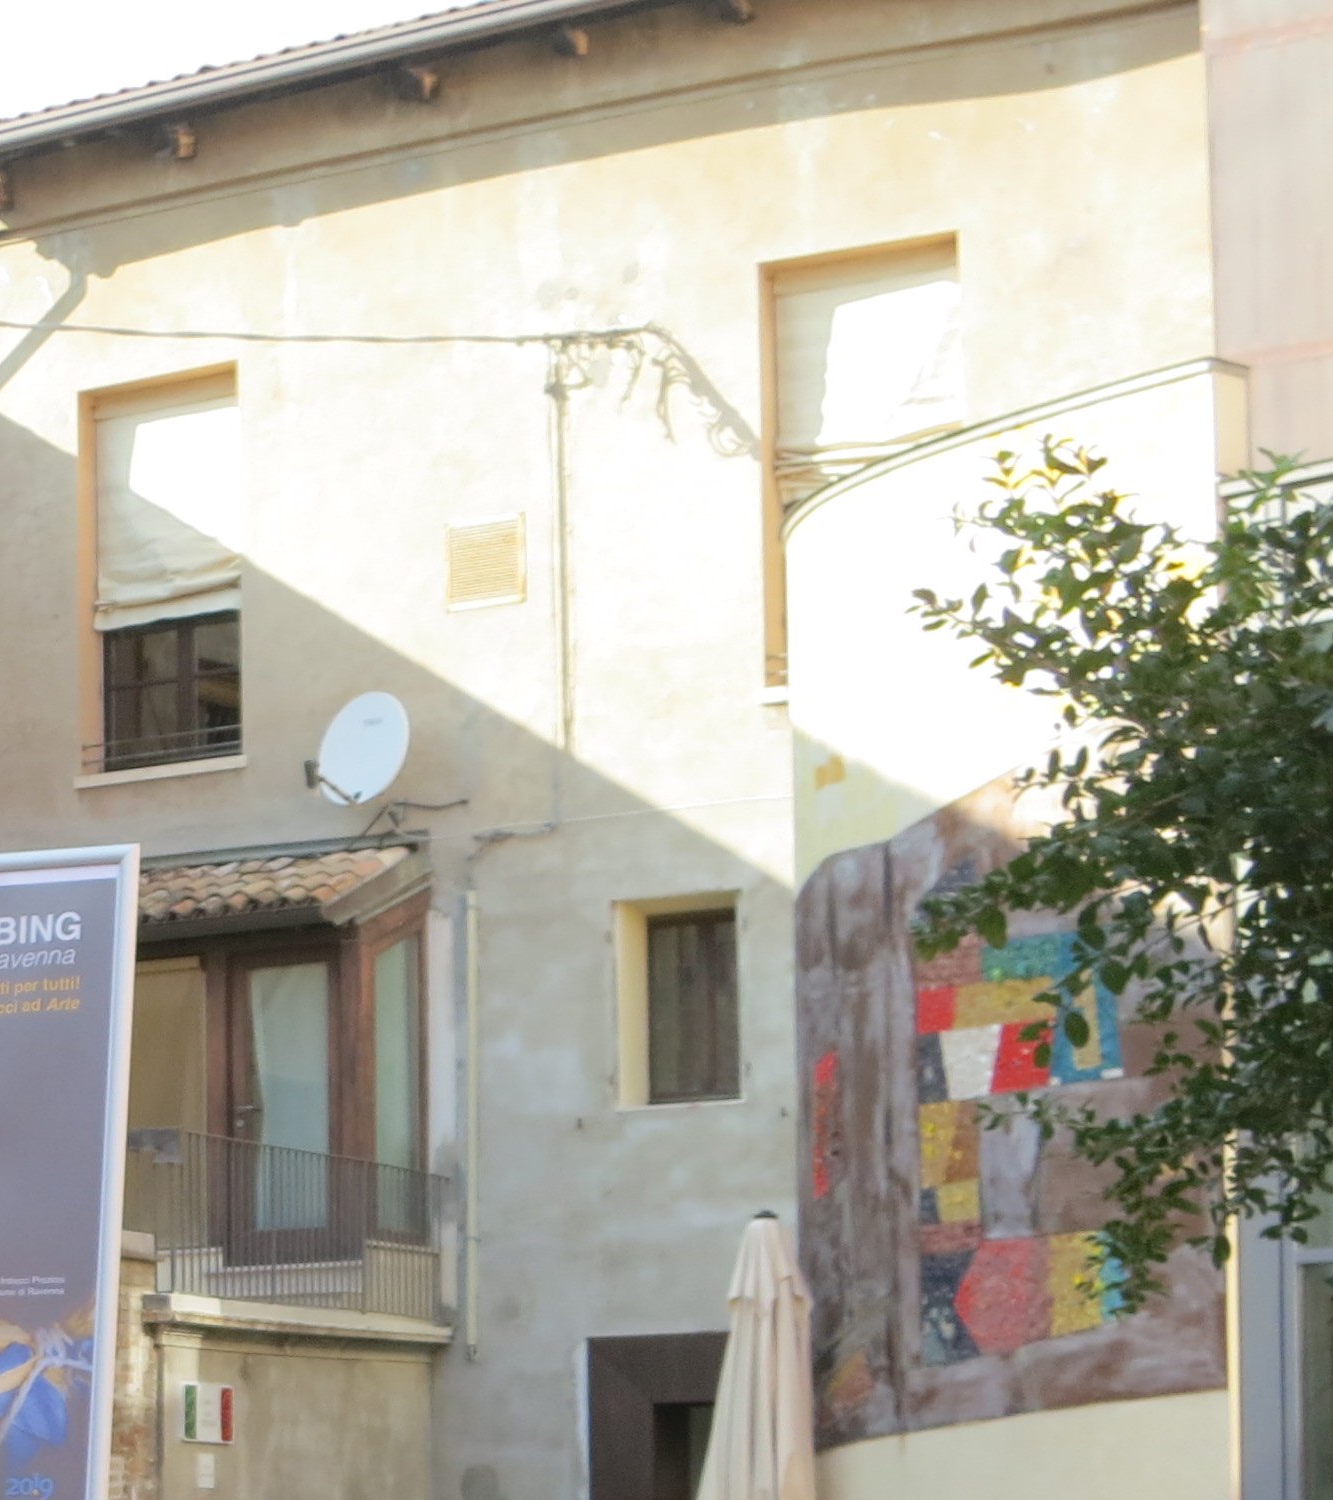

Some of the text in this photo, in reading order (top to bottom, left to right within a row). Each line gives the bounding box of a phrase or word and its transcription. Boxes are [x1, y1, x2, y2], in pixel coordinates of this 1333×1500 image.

[15, 980, 37, 997] per
[43, 976, 81, 992] tutti!
[22, 999, 41, 1013] ad
[46, 997, 81, 1012] Arte
[27, 1286, 64, 1295] Ravenna
